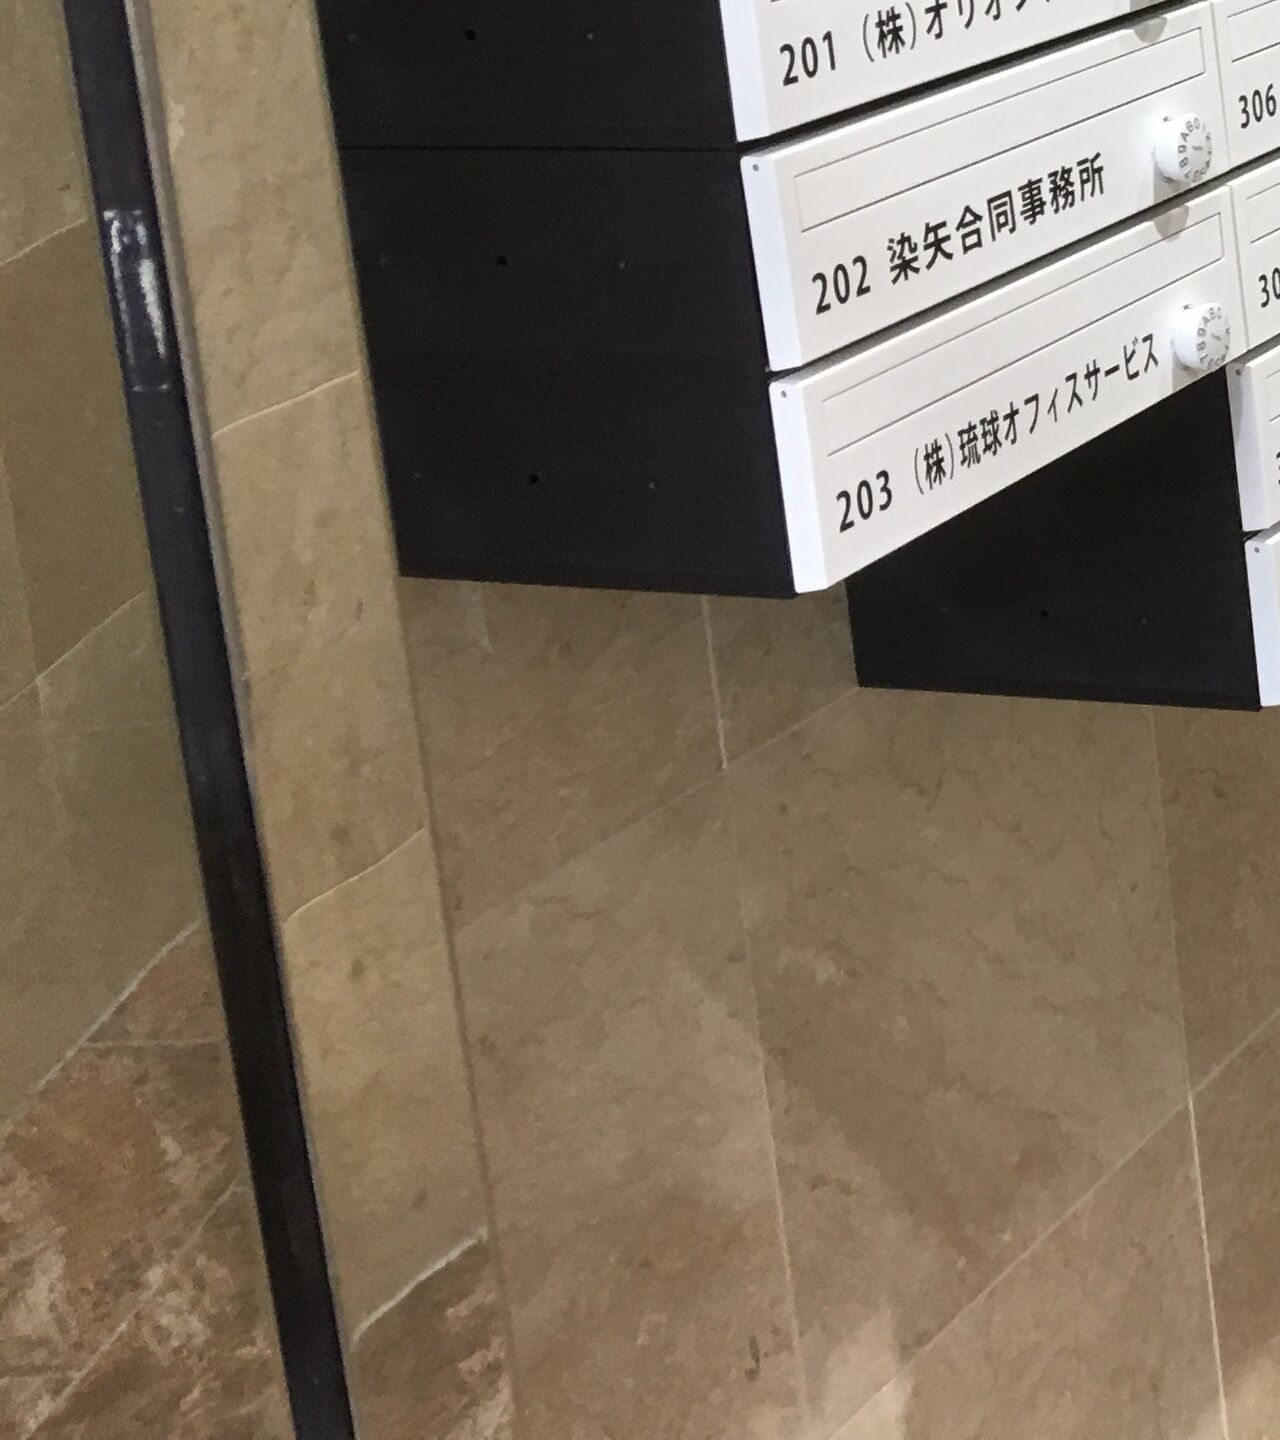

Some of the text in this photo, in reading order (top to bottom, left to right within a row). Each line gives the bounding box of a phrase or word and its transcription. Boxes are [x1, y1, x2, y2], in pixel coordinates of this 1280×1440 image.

[779, 30, 836, 87] 201
[1238, 83, 1277, 129] 306
[811, 152, 1106, 315] 202 染矢合同事務所
[836, 469, 893, 533] 203
